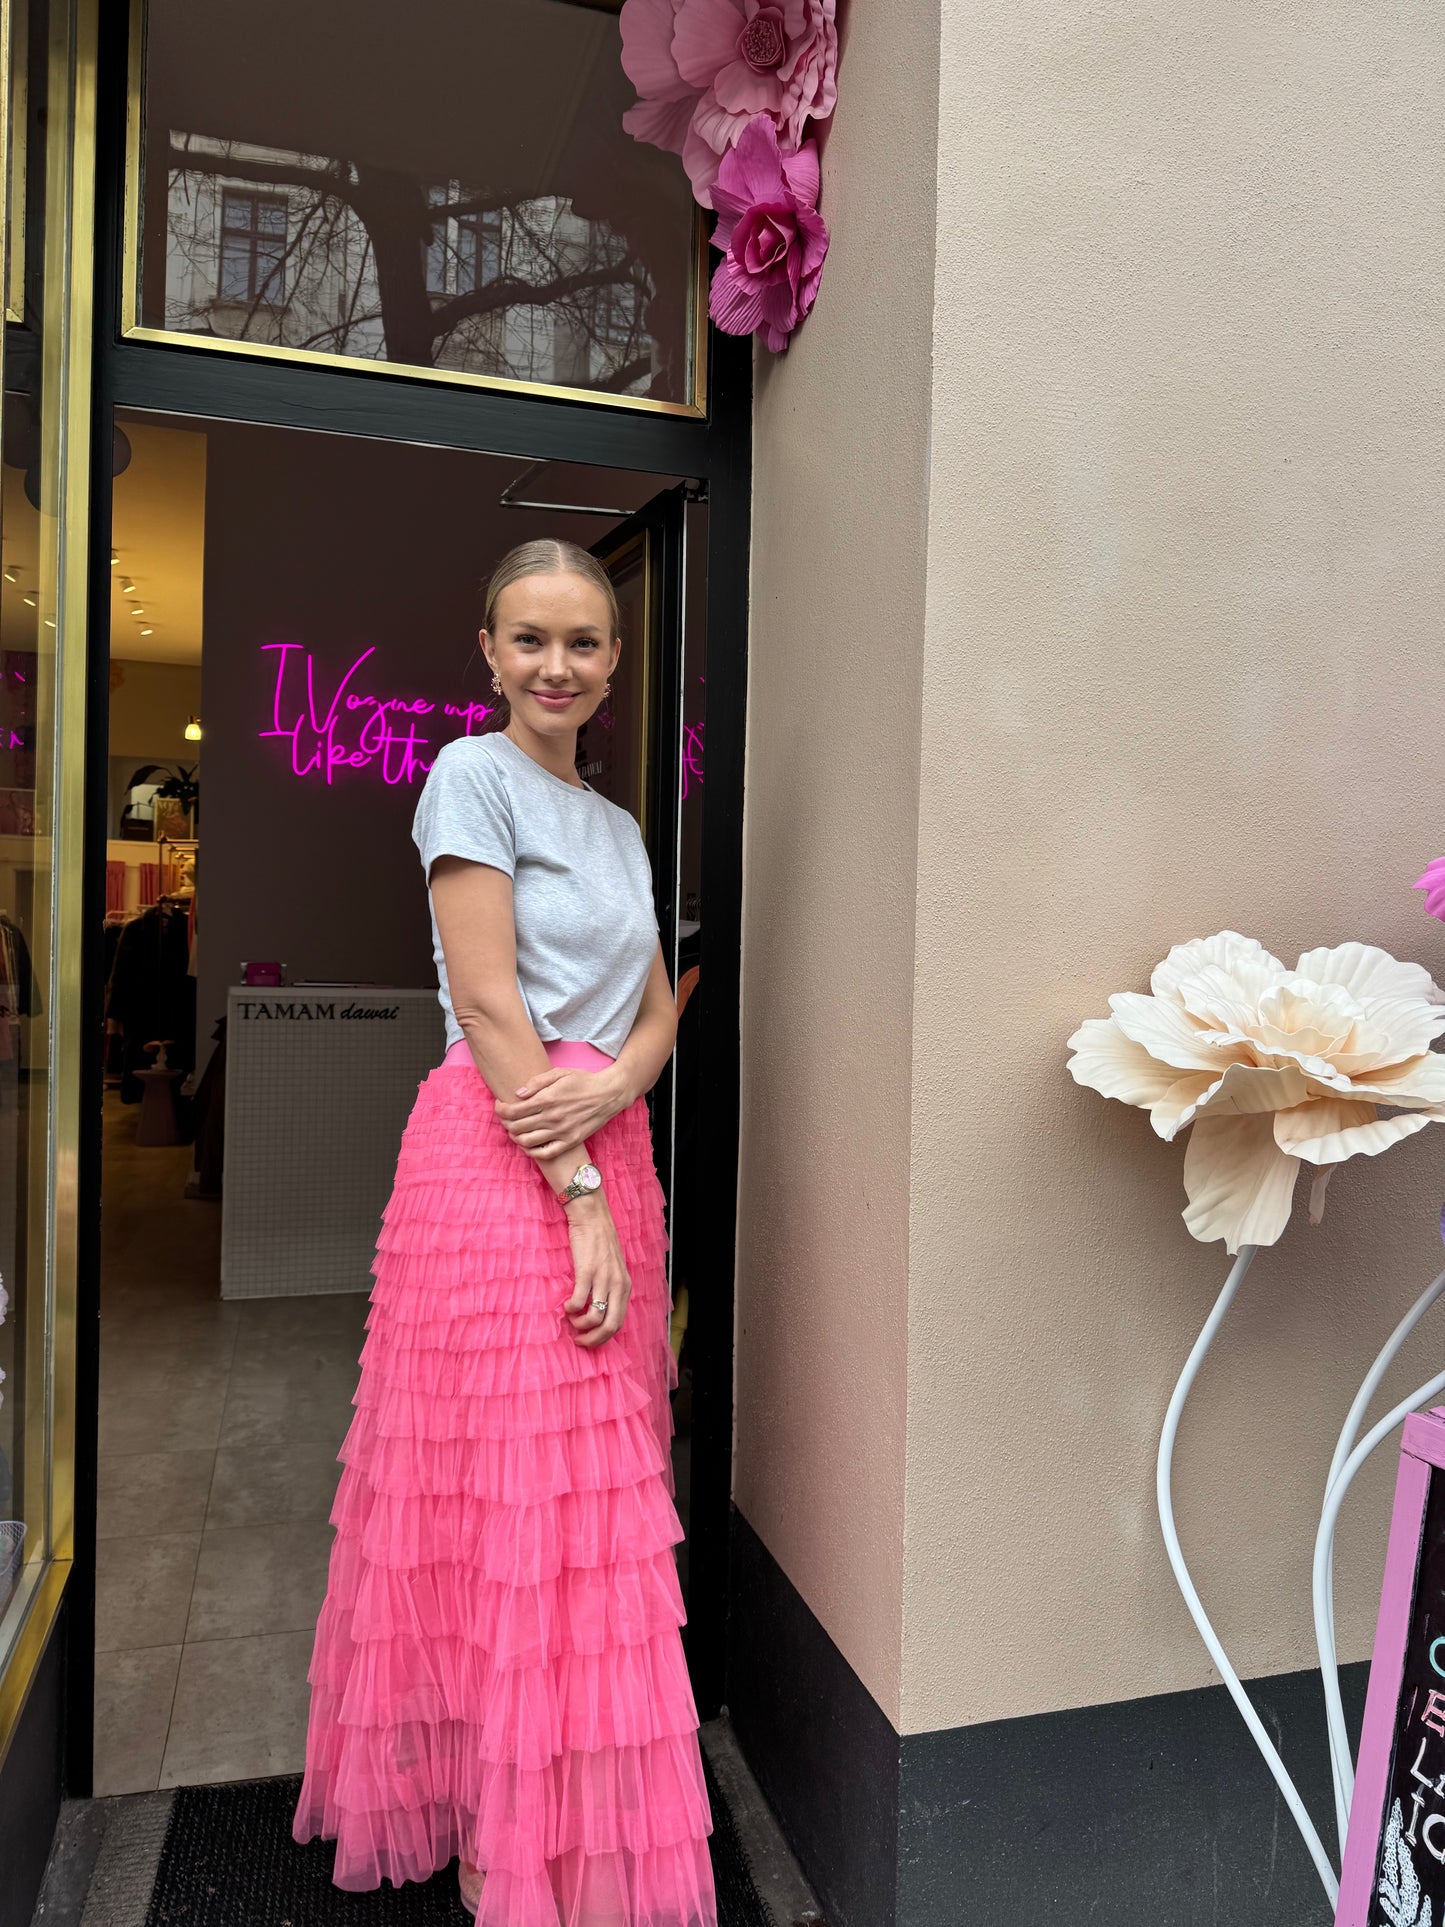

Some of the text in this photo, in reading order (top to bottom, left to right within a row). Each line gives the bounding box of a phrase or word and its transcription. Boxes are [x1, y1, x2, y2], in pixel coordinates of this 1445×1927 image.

[257, 643, 495, 755] I Vogue up
[371, 722, 437, 785] th
[237, 1003, 400, 1021] TAMAM dawai
